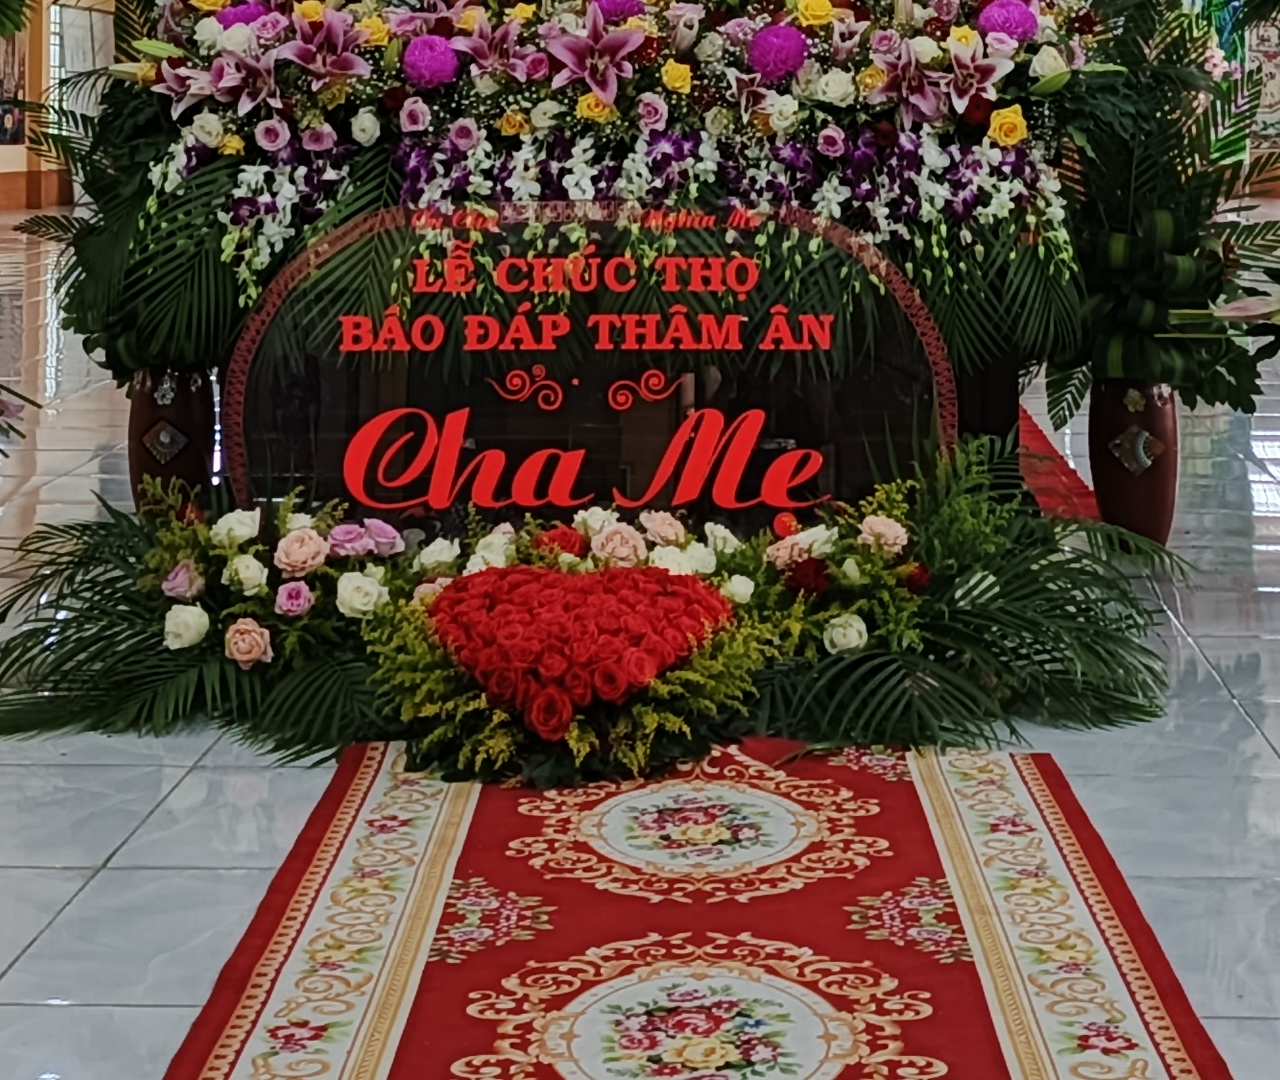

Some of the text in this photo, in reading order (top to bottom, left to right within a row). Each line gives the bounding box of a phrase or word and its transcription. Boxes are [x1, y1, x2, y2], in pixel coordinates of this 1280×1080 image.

[411, 239, 761, 302] LỄ CHÚC THỌ
[338, 301, 835, 353] BÁO ĐÁP THÂM ÂN
[342, 406, 832, 539] Cha Mẹ
